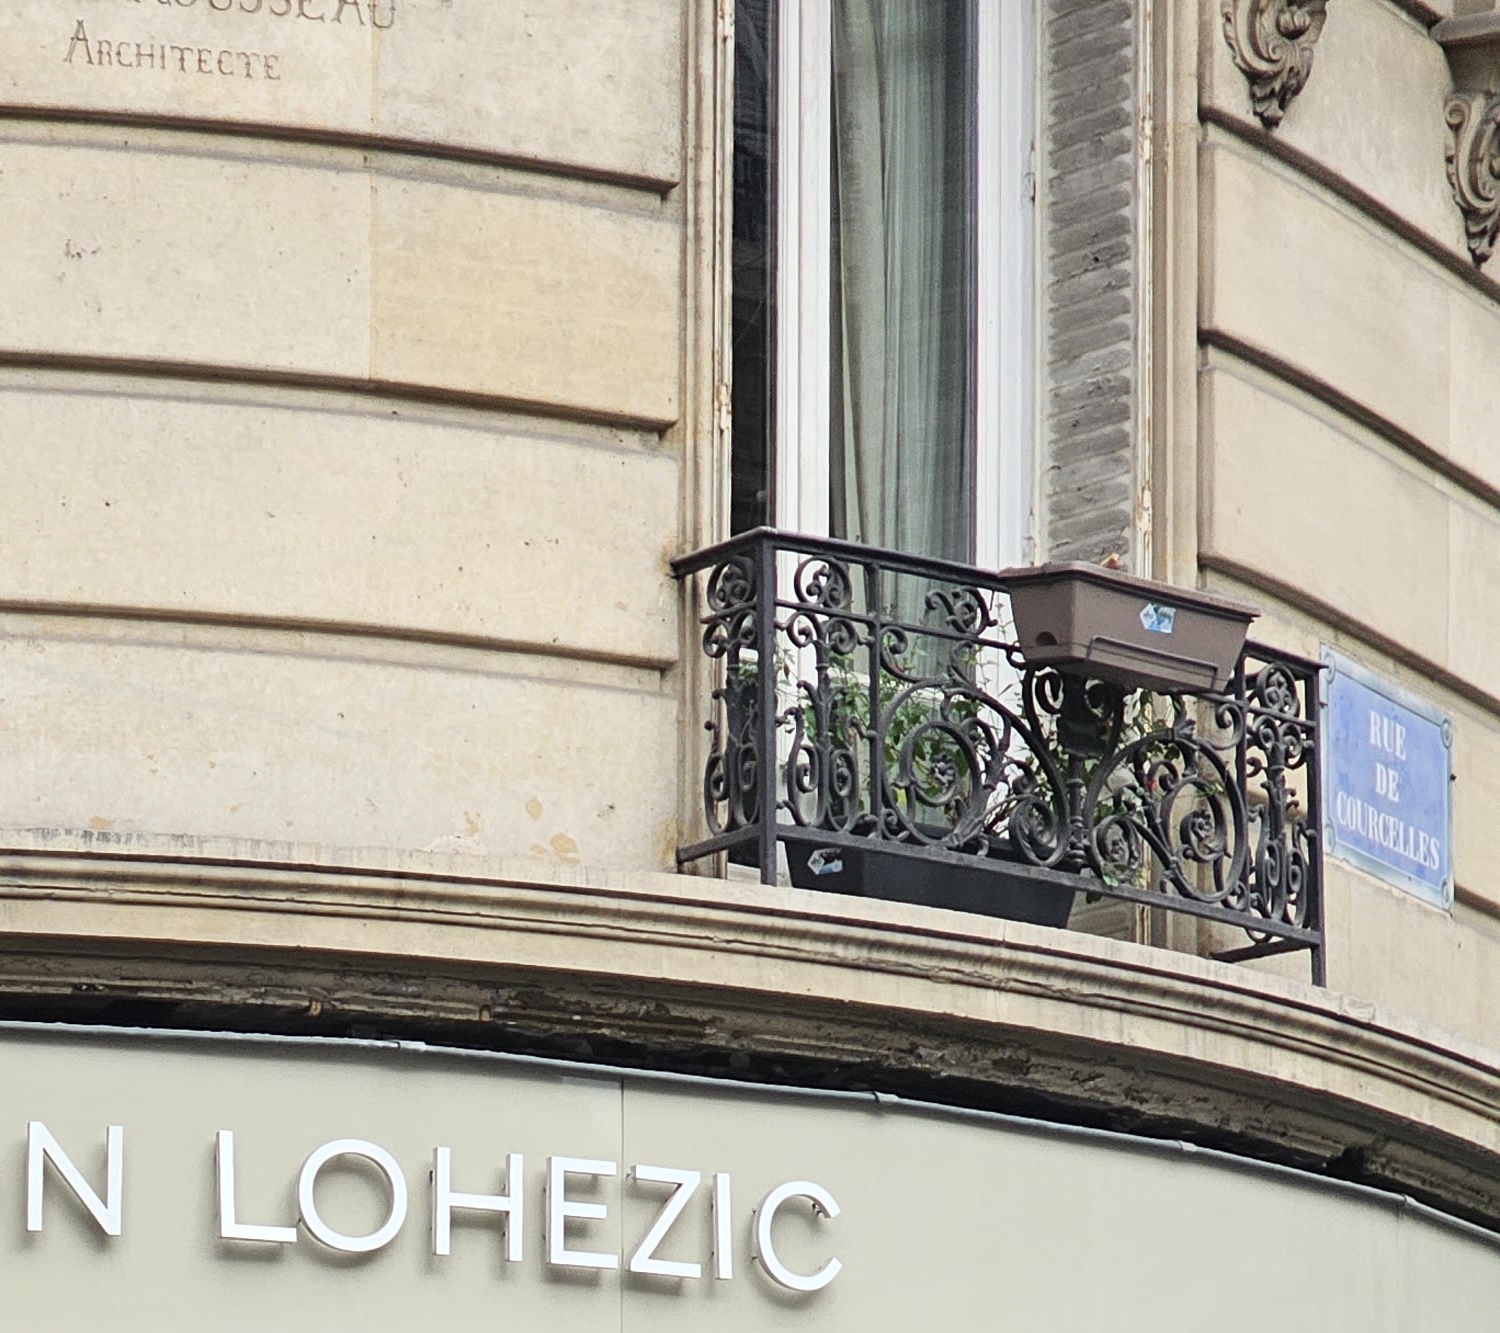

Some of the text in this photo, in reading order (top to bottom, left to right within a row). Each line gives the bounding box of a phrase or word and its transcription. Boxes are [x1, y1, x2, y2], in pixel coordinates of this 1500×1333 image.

[1369, 711, 1406, 759] RUE
[1375, 762, 1399, 802] DE
[1336, 792, 1440, 870] COURCELLES
[215, 1128, 843, 1294] LOHEZIC
